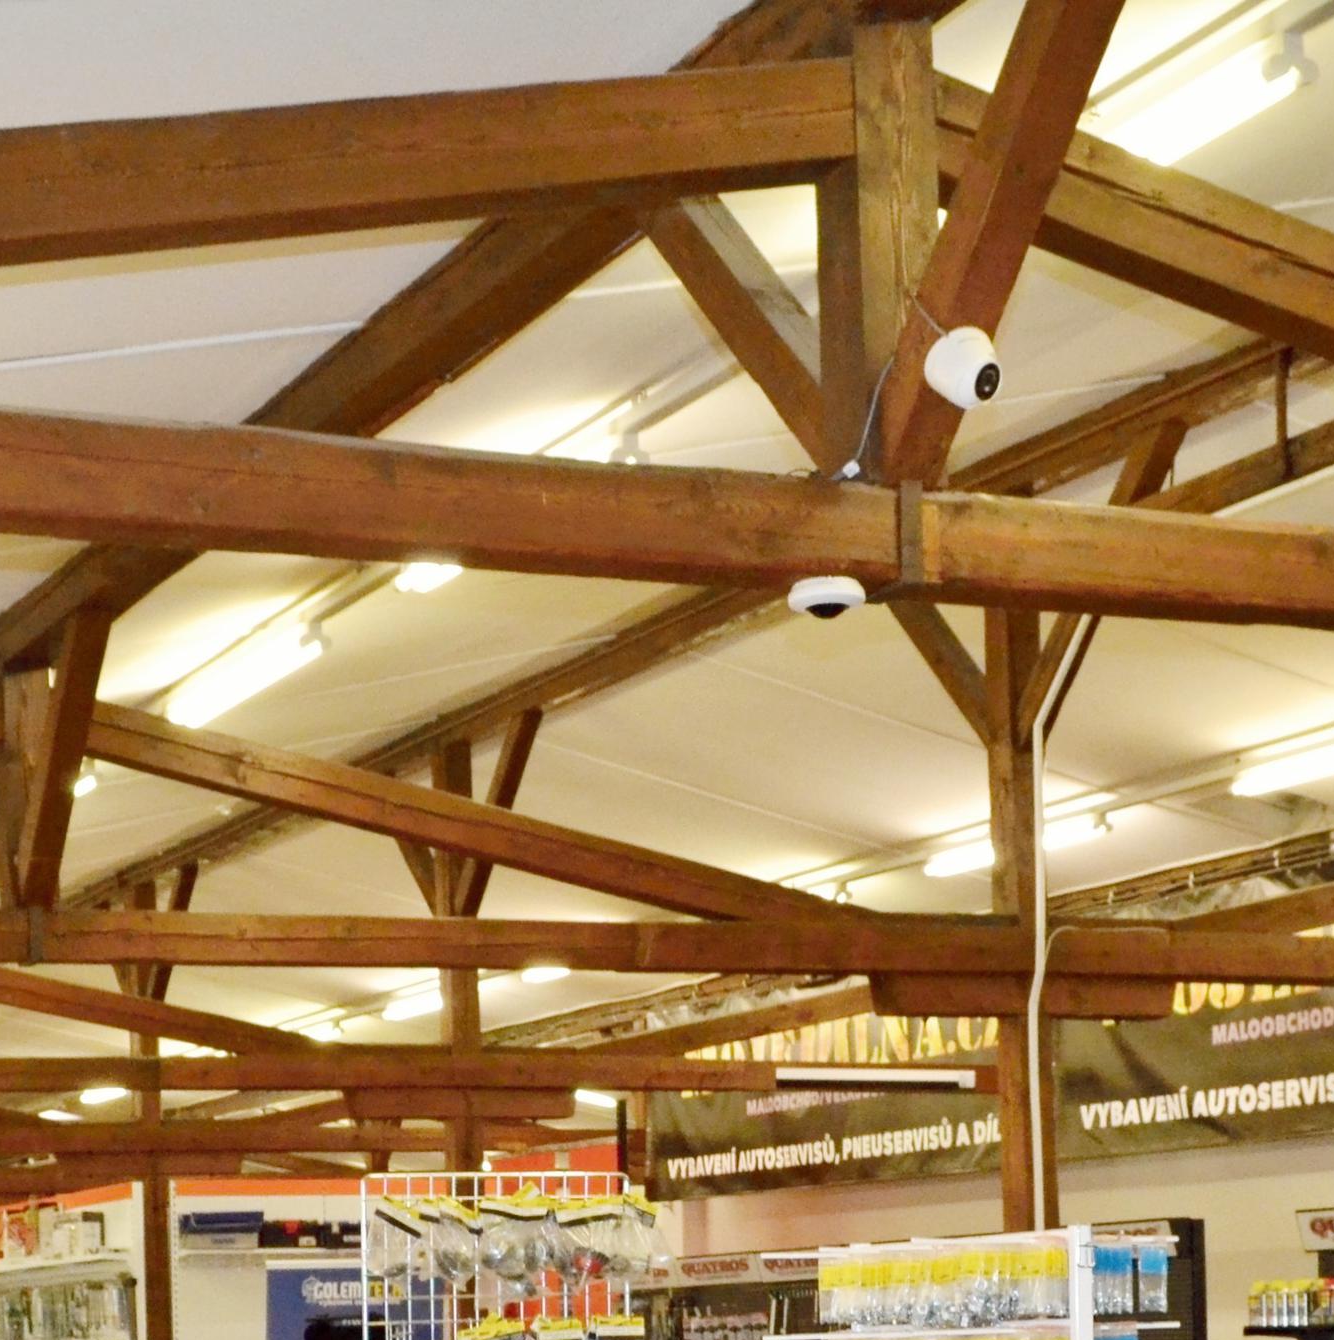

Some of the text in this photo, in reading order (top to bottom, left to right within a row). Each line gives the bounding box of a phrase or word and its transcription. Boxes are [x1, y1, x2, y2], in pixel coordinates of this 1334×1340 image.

[1080, 1086, 1191, 1131] VYBAVENÍ
[667, 1112, 1002, 1180] VYBAVENÍ AUTOSERVISŮ, PNEUSERVISŮ A DÍL
[681, 1257, 750, 1279] QUATROS
